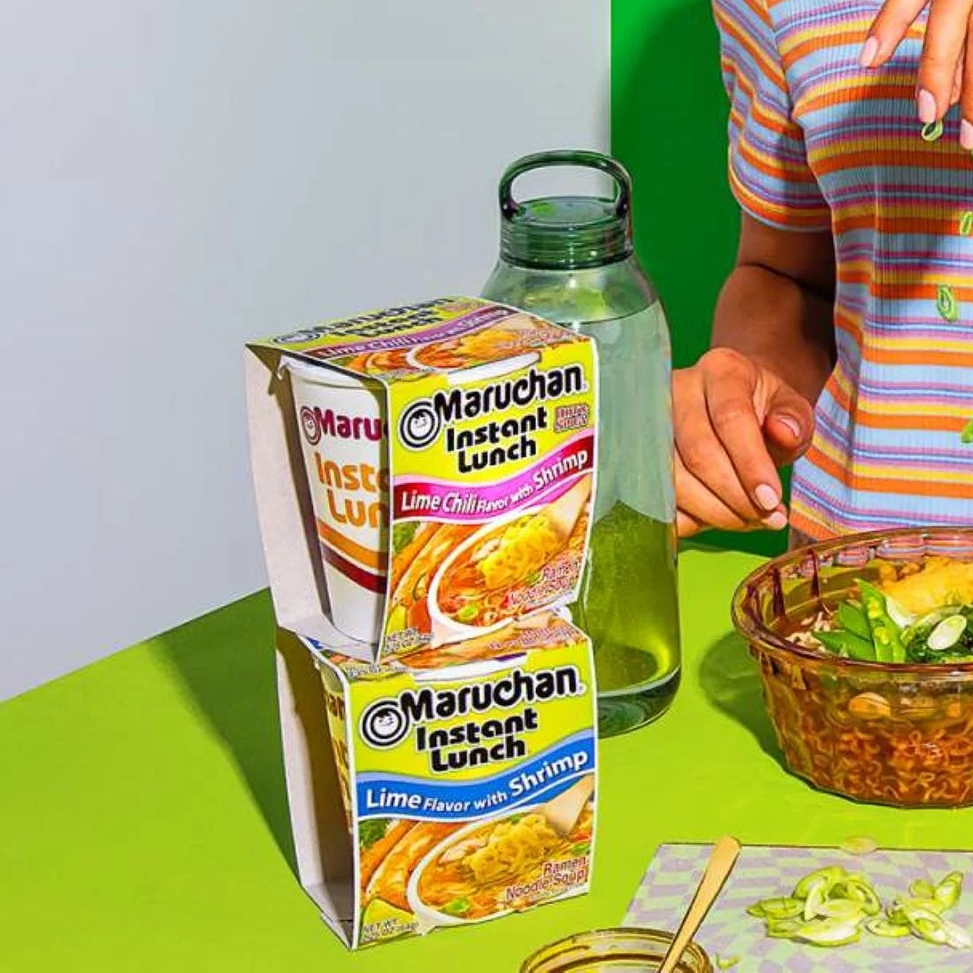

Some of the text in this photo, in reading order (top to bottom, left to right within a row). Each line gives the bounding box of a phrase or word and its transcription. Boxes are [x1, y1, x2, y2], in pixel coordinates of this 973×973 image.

[434, 365, 582, 421] Maruchan
[446, 407, 548, 452] Instant
[458, 437, 537, 473] Lunch
[401, 489, 440, 512] Lime
[442, 490, 480, 515] Chili
[533, 448, 589, 490] Shrimp
[400, 667, 577, 722] Maruchan
[416, 708, 538, 751] Instant
[430, 738, 526, 773] Lunch
[366, 750, 589, 813] Lime Flavor with Shrimp
[543, 856, 586, 876] Ramen
[506, 879, 549, 901] Noodle
